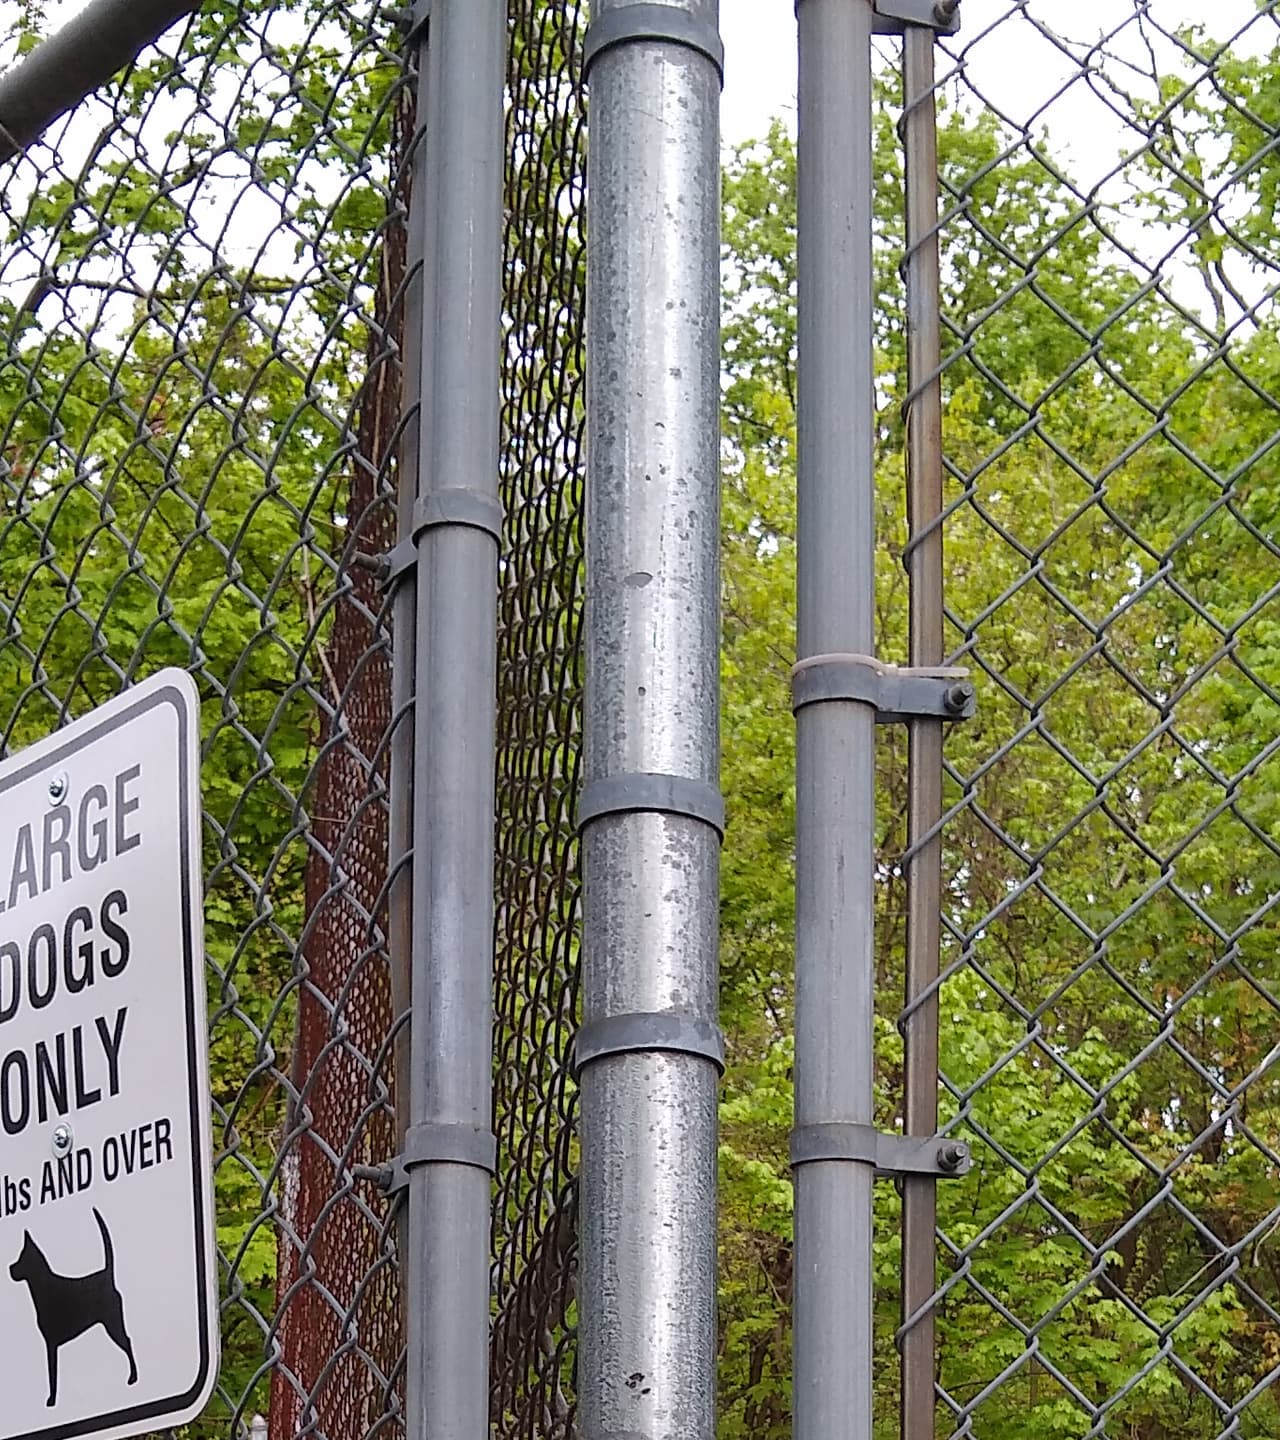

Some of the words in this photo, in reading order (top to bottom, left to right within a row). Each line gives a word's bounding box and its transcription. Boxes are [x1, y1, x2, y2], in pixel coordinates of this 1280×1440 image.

[0, 1006, 129, 1136] ONLY
[39, 1147, 93, 1205] AND
[102, 1117, 174, 1182] OVER
